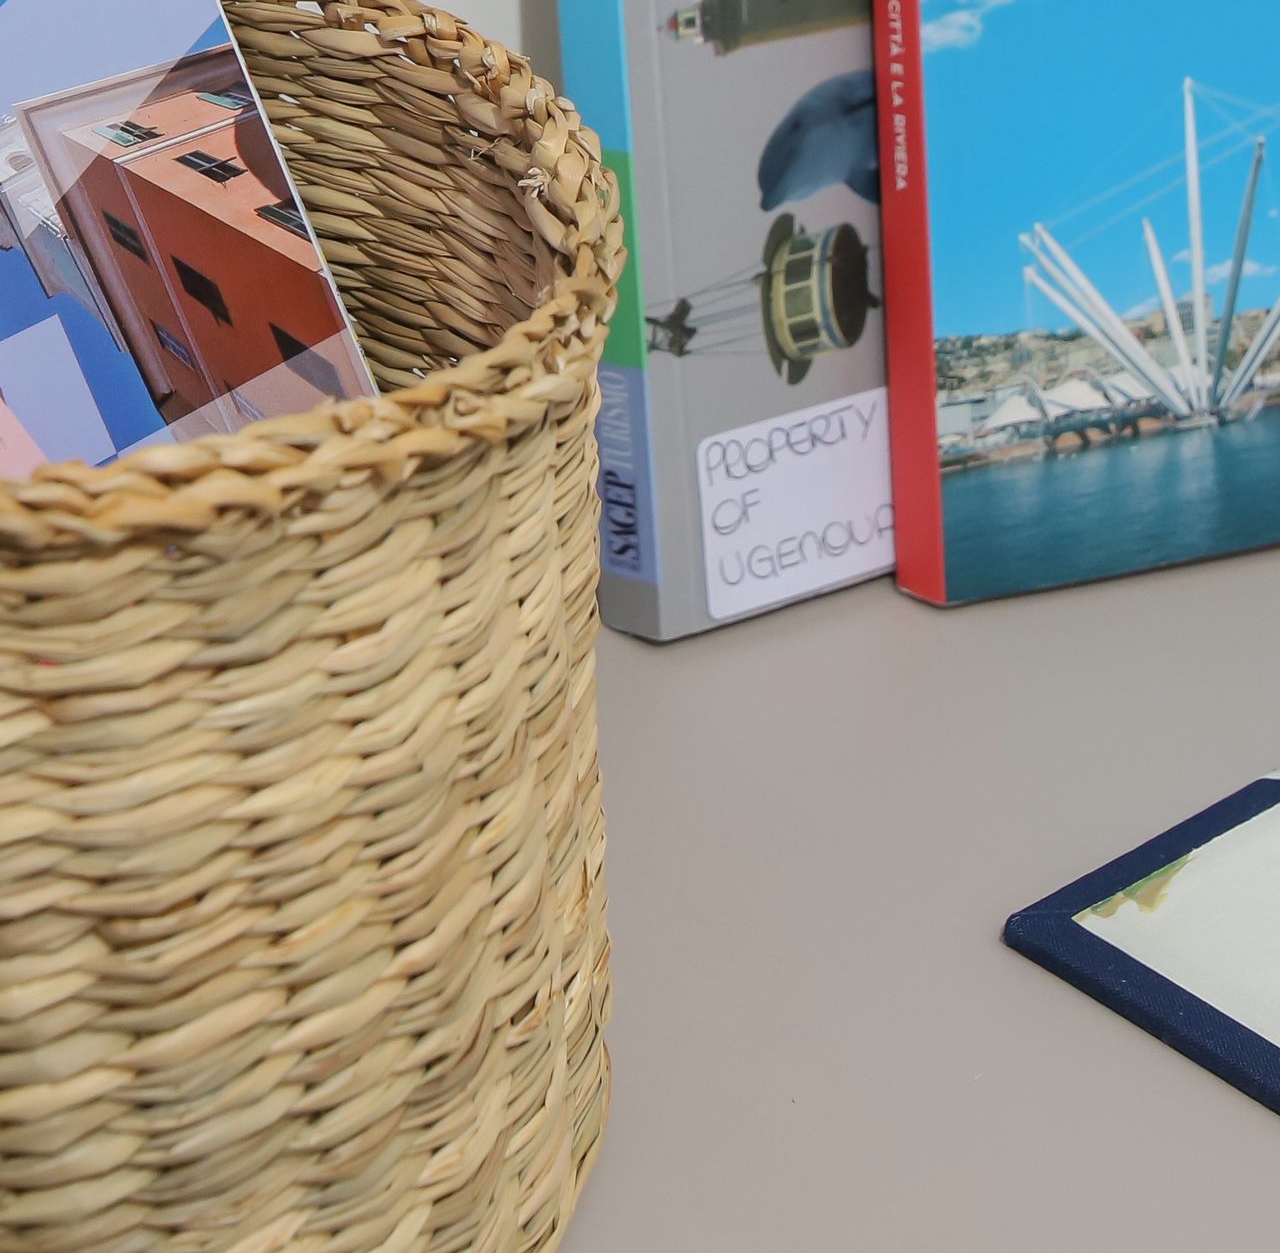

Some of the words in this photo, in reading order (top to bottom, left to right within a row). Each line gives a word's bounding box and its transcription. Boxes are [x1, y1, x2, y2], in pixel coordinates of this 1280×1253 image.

[890, 62, 905, 77] E
[891, 81, 906, 107] LA
[892, 113, 909, 191] RIVIERA
[600, 370, 633, 470] TURISMO
[705, 401, 878, 486] PROPERTY
[604, 469, 641, 568] SAGEP
[711, 489, 760, 535] OF
